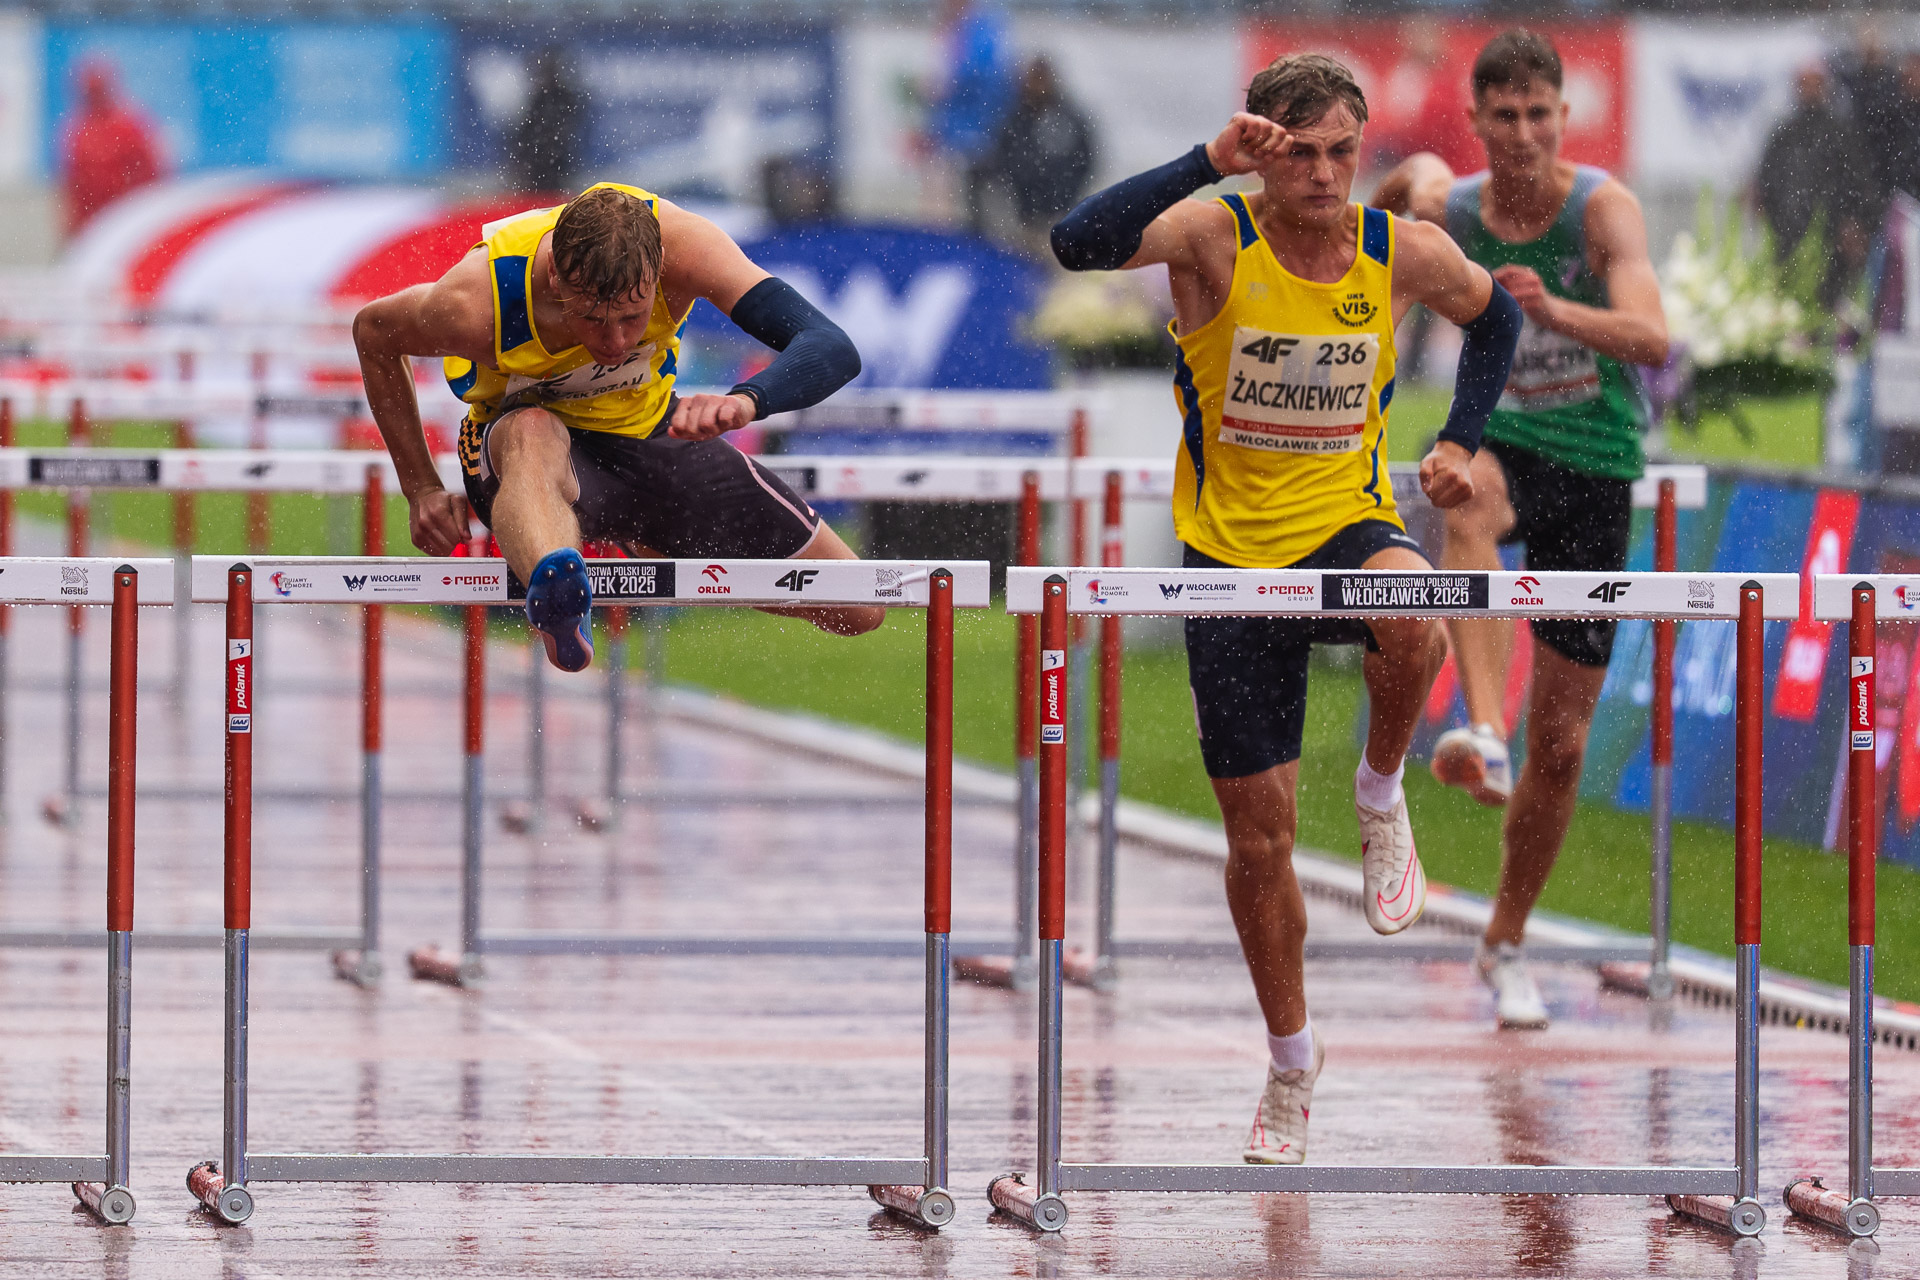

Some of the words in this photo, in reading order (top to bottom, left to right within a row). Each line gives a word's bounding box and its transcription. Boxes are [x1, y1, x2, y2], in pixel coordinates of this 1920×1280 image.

[1342, 301, 1370, 315] VIS
[1241, 336, 1300, 364] 4F
[1316, 342, 1367, 365] 236
[1230, 370, 1367, 411] ŻACZKIEWICZ
[1234, 433, 1319, 450] WŁOCŁAWEK
[1321, 440, 1350, 450] 2025
[614, 566, 640, 576] POLSKI
[641, 565, 656, 576] U20
[370, 574, 421, 583] WŁOCŁAWEK
[455, 576, 500, 585] renex
[620, 576, 656, 594] 2025
[774, 569, 820, 592] 4F
[1341, 577, 1353, 588] 79.
[1354, 577, 1372, 588] PZLA
[1373, 577, 1426, 588] MISTRZOSTWA
[1427, 577, 1453, 588] POLSKI
[1454, 577, 1470, 588] U20
[697, 586, 731, 594] ORLEN
[875, 588, 903, 598] Nestlé
[1186, 583, 1237, 591] WŁOCŁAWEK
[1270, 586, 1315, 595] renex
[1587, 582, 1632, 603] 4F
[1342, 588, 1430, 606] WŁOCŁAWEK
[1433, 587, 1470, 605] 2025
[1511, 597, 1544, 606] ORLEN
[1687, 599, 1715, 609] Nestlé
[235, 663, 248, 709] polanik
[1047, 674, 1060, 720] polanik
[1857, 680, 1870, 726] polanik
